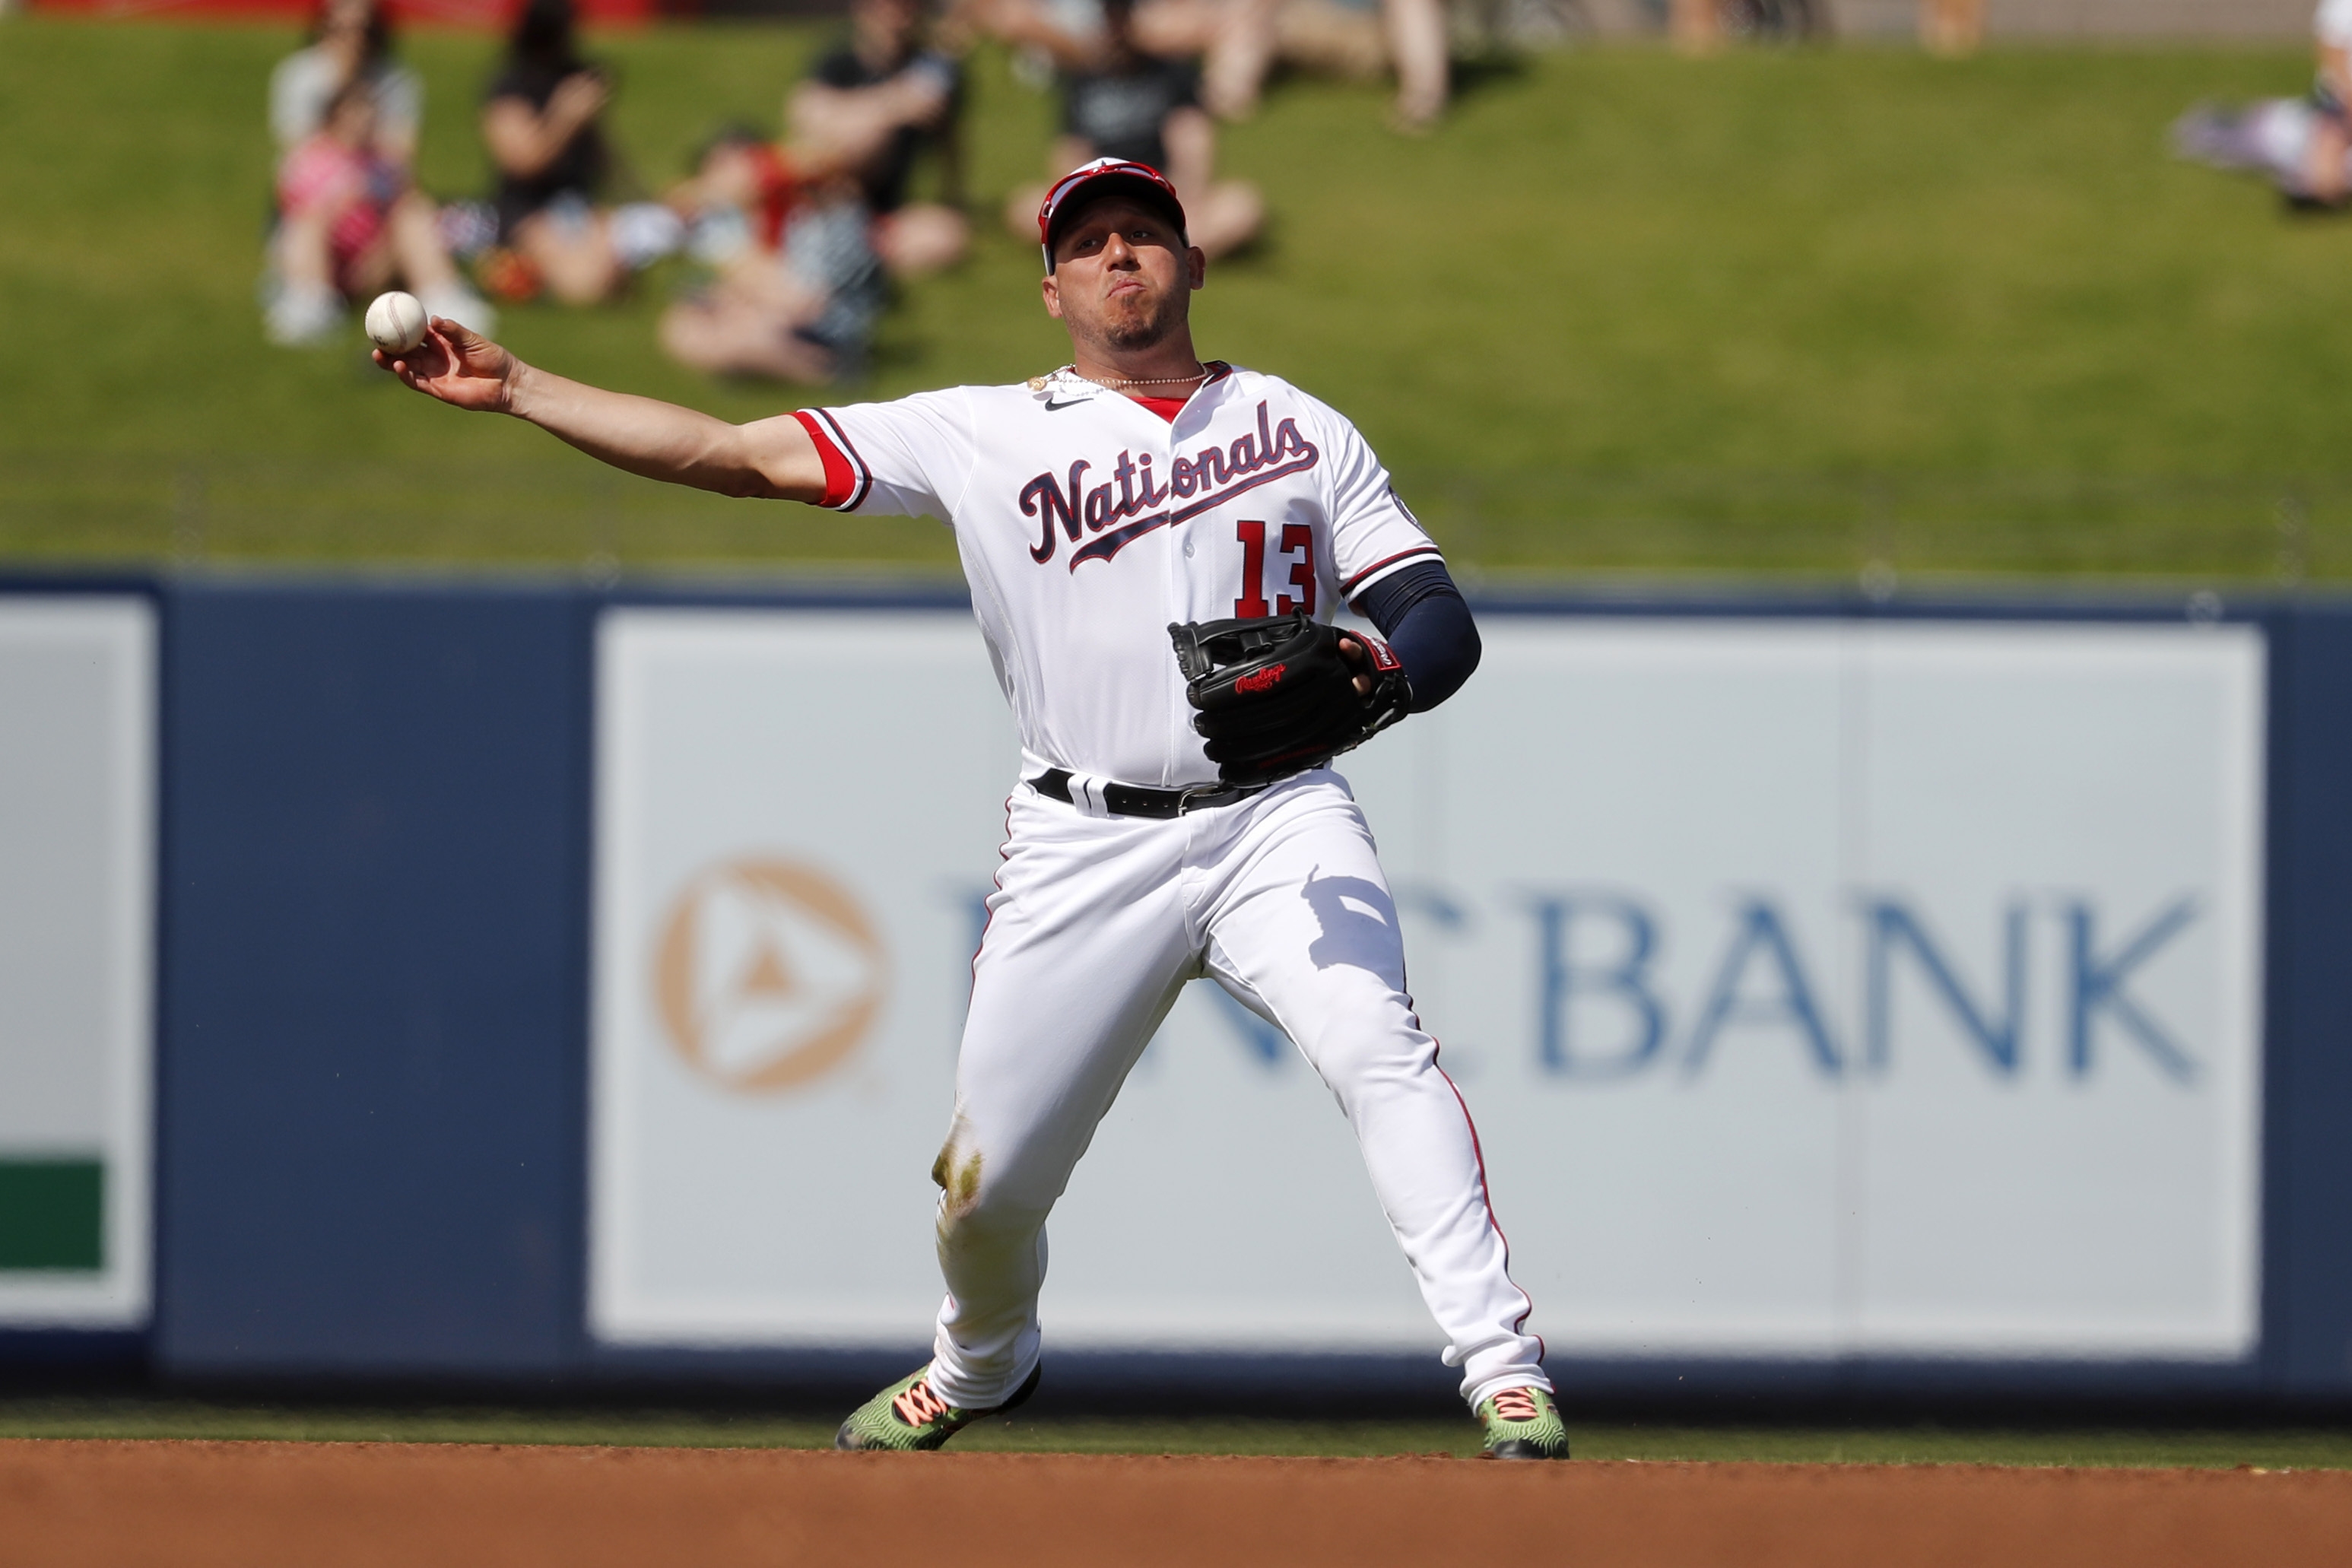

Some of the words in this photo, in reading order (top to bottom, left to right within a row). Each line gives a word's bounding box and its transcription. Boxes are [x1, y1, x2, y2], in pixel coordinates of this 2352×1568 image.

[1019, 399, 1319, 566] Nationals
[1235, 520, 1316, 619] 13
[1525, 893, 2198, 1081] BANK
